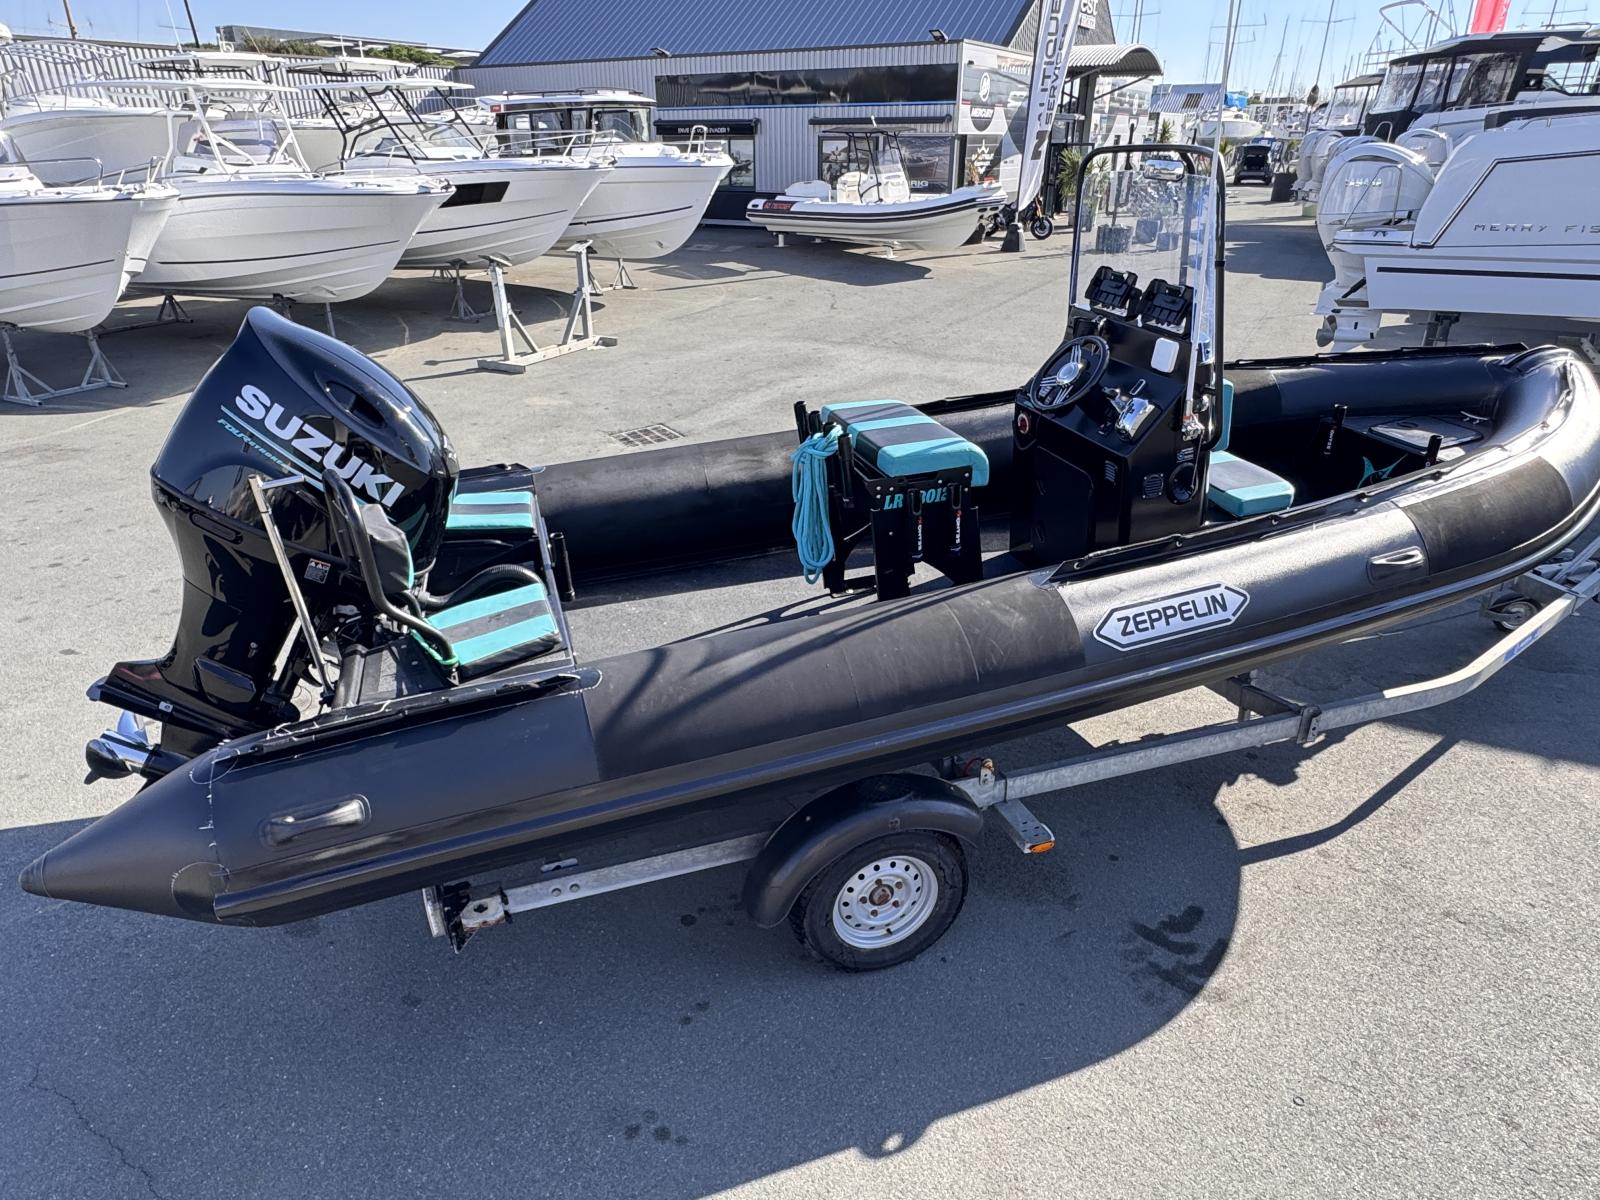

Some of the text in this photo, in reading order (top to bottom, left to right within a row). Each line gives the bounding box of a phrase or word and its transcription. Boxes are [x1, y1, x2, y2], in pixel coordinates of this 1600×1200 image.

[1473, 223, 1548, 232] MERRY
[235, 384, 405, 508] SUZUKI
[884, 494, 903, 510] LR
[1116, 592, 1228, 637] ZEPPELIN
